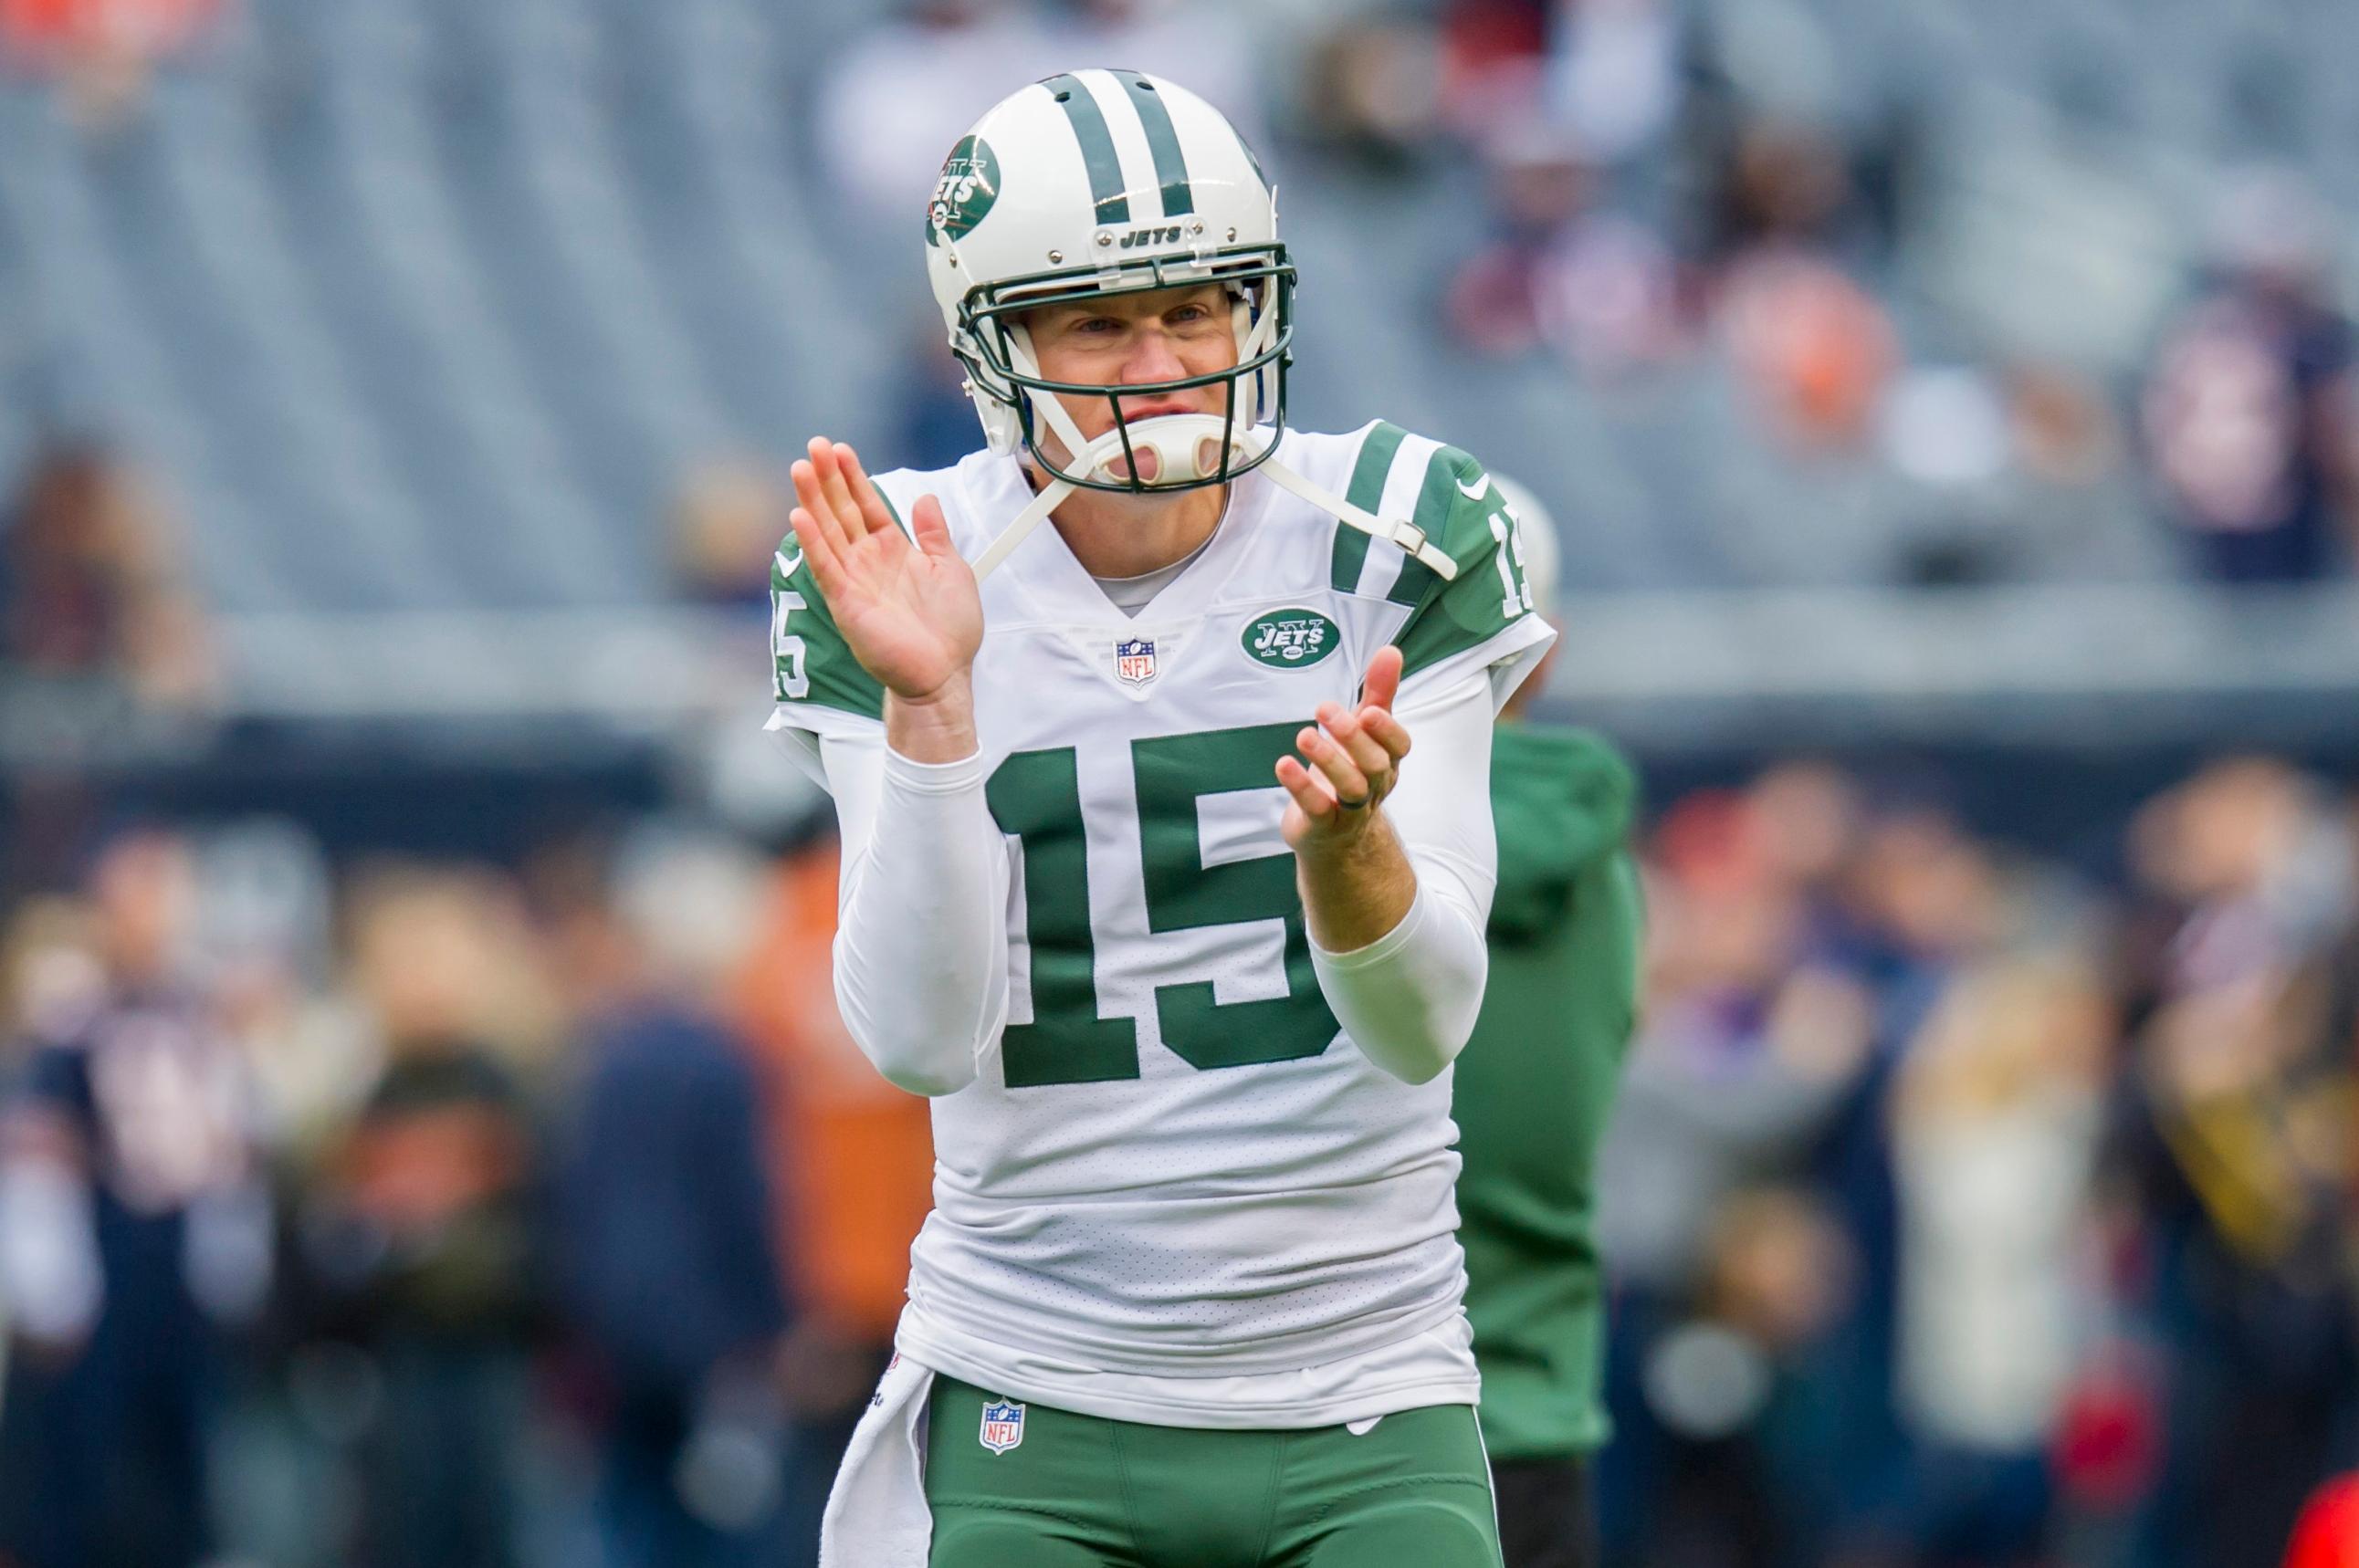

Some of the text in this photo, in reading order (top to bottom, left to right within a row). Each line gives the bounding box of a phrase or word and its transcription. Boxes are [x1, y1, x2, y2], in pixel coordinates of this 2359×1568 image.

[930, 175, 978, 203] ETS
[1120, 226, 1181, 248] JETS
[1254, 628, 1324, 650] JETS
[1121, 656, 1153, 678] NFL
[984, 720, 1342, 1088] 15
[986, 1423, 1016, 1445] NFL
